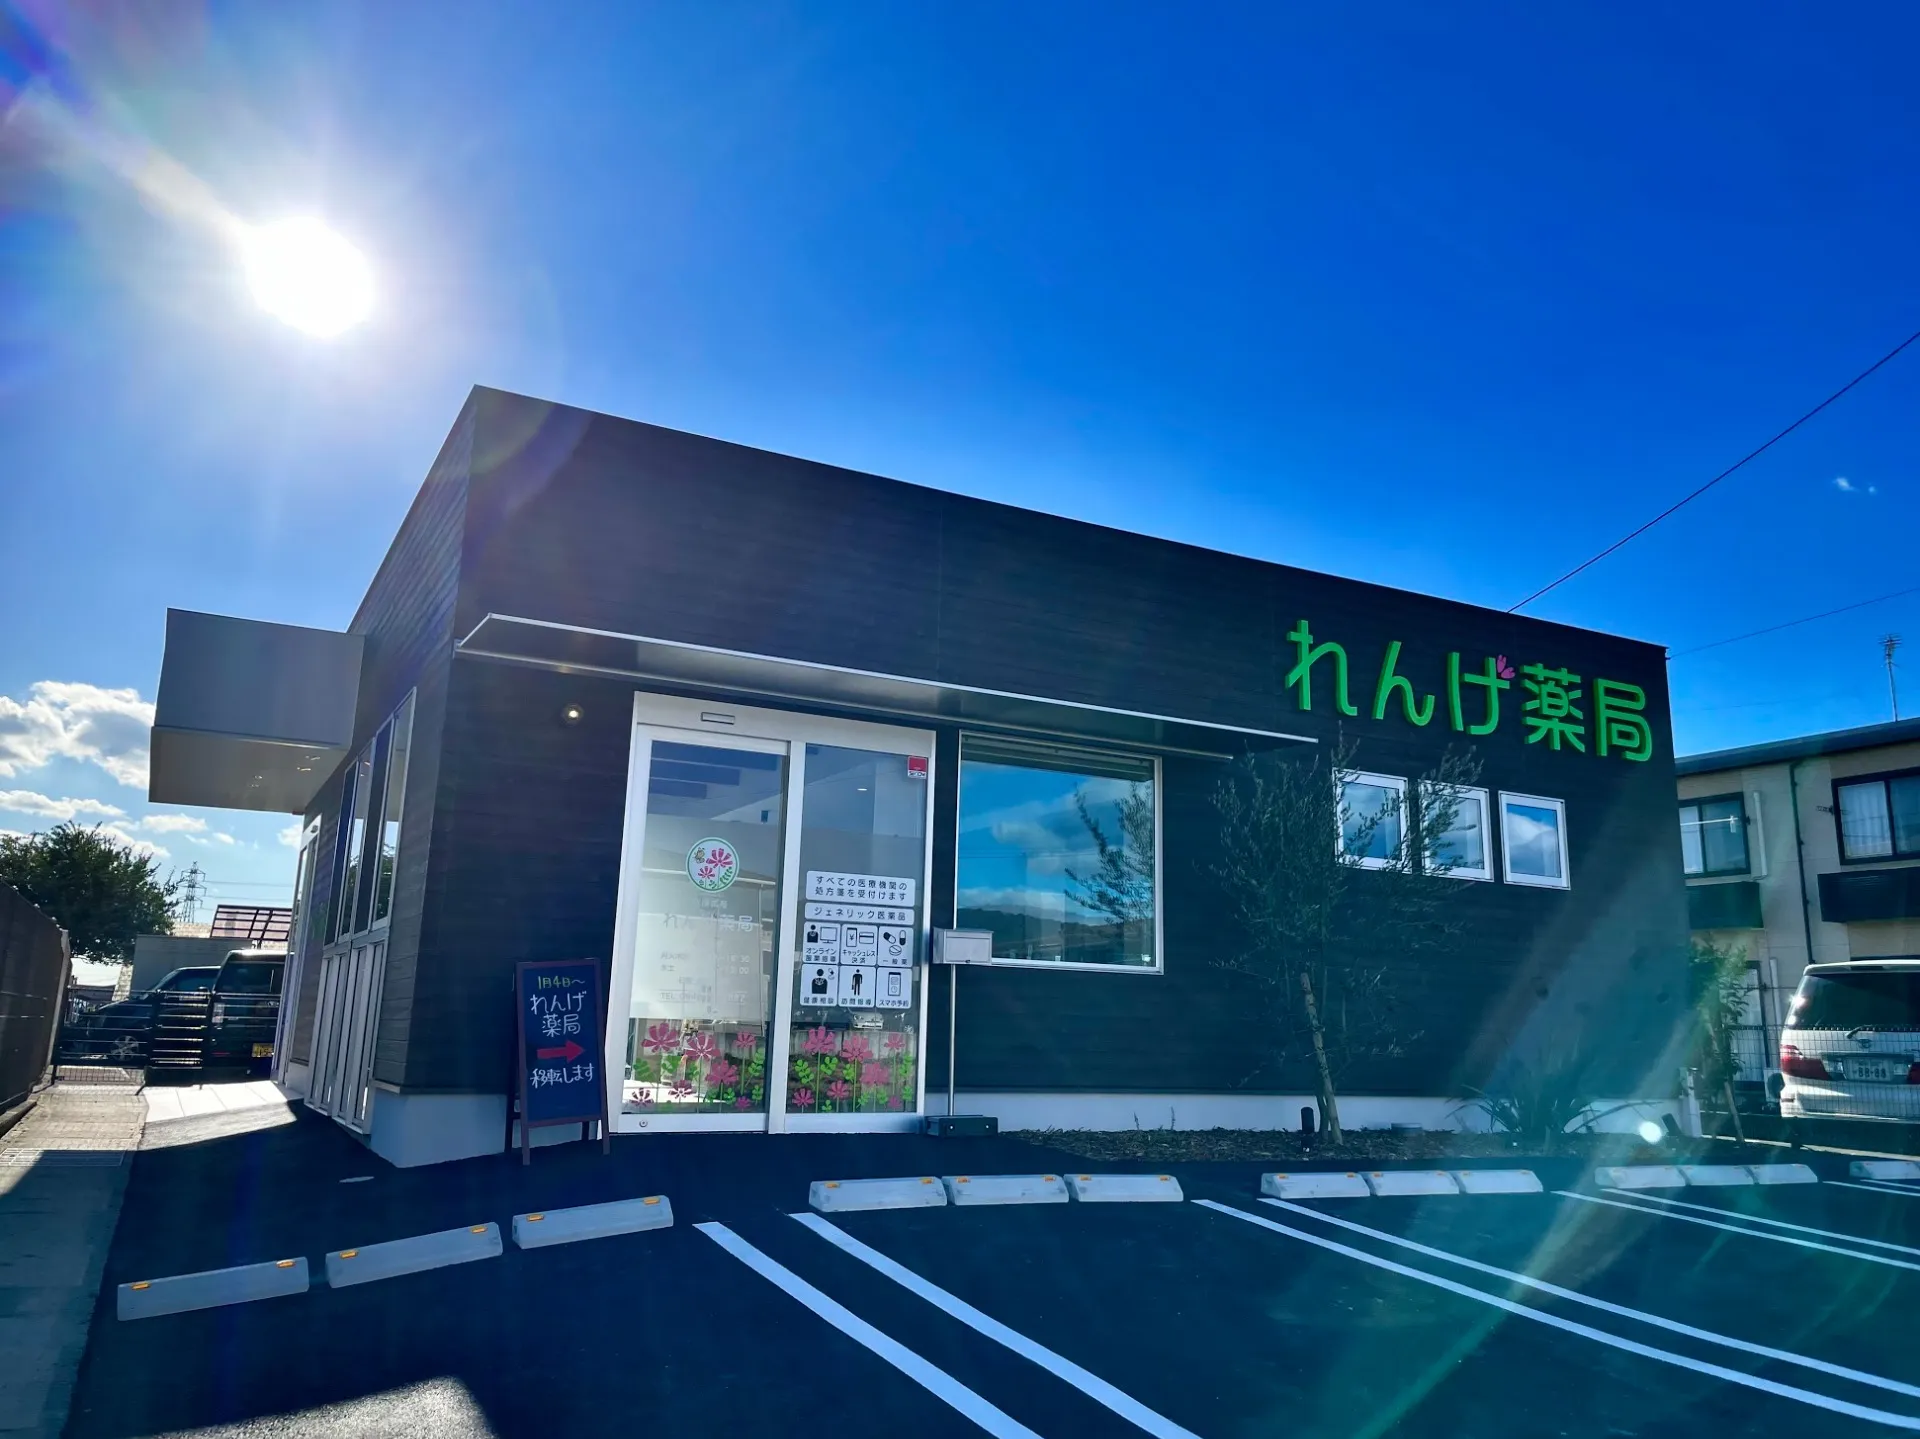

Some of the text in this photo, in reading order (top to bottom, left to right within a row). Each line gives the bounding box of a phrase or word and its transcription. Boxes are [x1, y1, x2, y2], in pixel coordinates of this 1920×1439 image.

[1285, 619, 1653, 762] れんげ薬局
[816, 876, 908, 891] すべての医療機関の
[815, 886, 906, 901] 処方箋を受付けます
[814, 907, 906, 921] ジェネリック医薬品
[805, 947, 837, 955] オンライン
[842, 949, 876, 957] キャッシュレス
[529, 990, 587, 1015] れんげ
[542, 1013, 581, 1038] 薬局
[530, 1062, 595, 1089] 移転します
